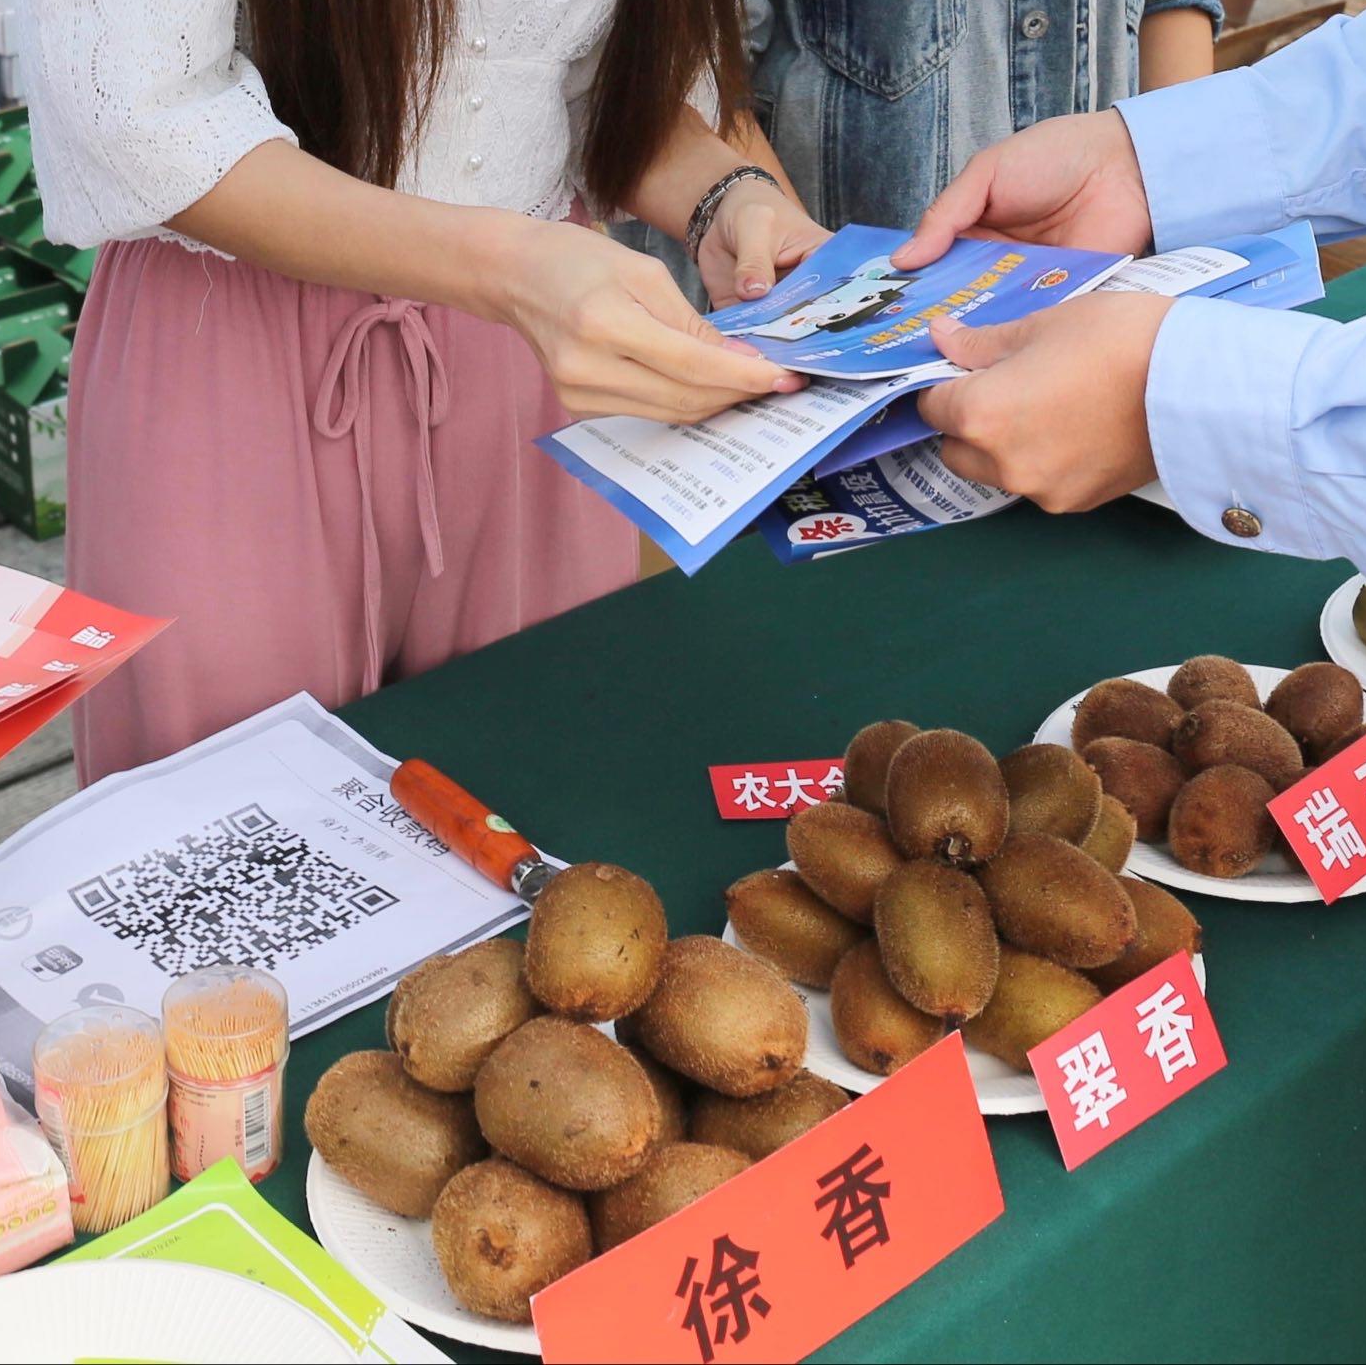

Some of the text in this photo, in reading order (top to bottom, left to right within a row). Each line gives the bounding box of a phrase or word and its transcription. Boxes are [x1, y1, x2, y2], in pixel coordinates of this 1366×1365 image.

[331, 777, 450, 857] 聚合收款码
[1055, 981, 1198, 1131] 翠香
[674, 1142, 892, 1365] 徐香
